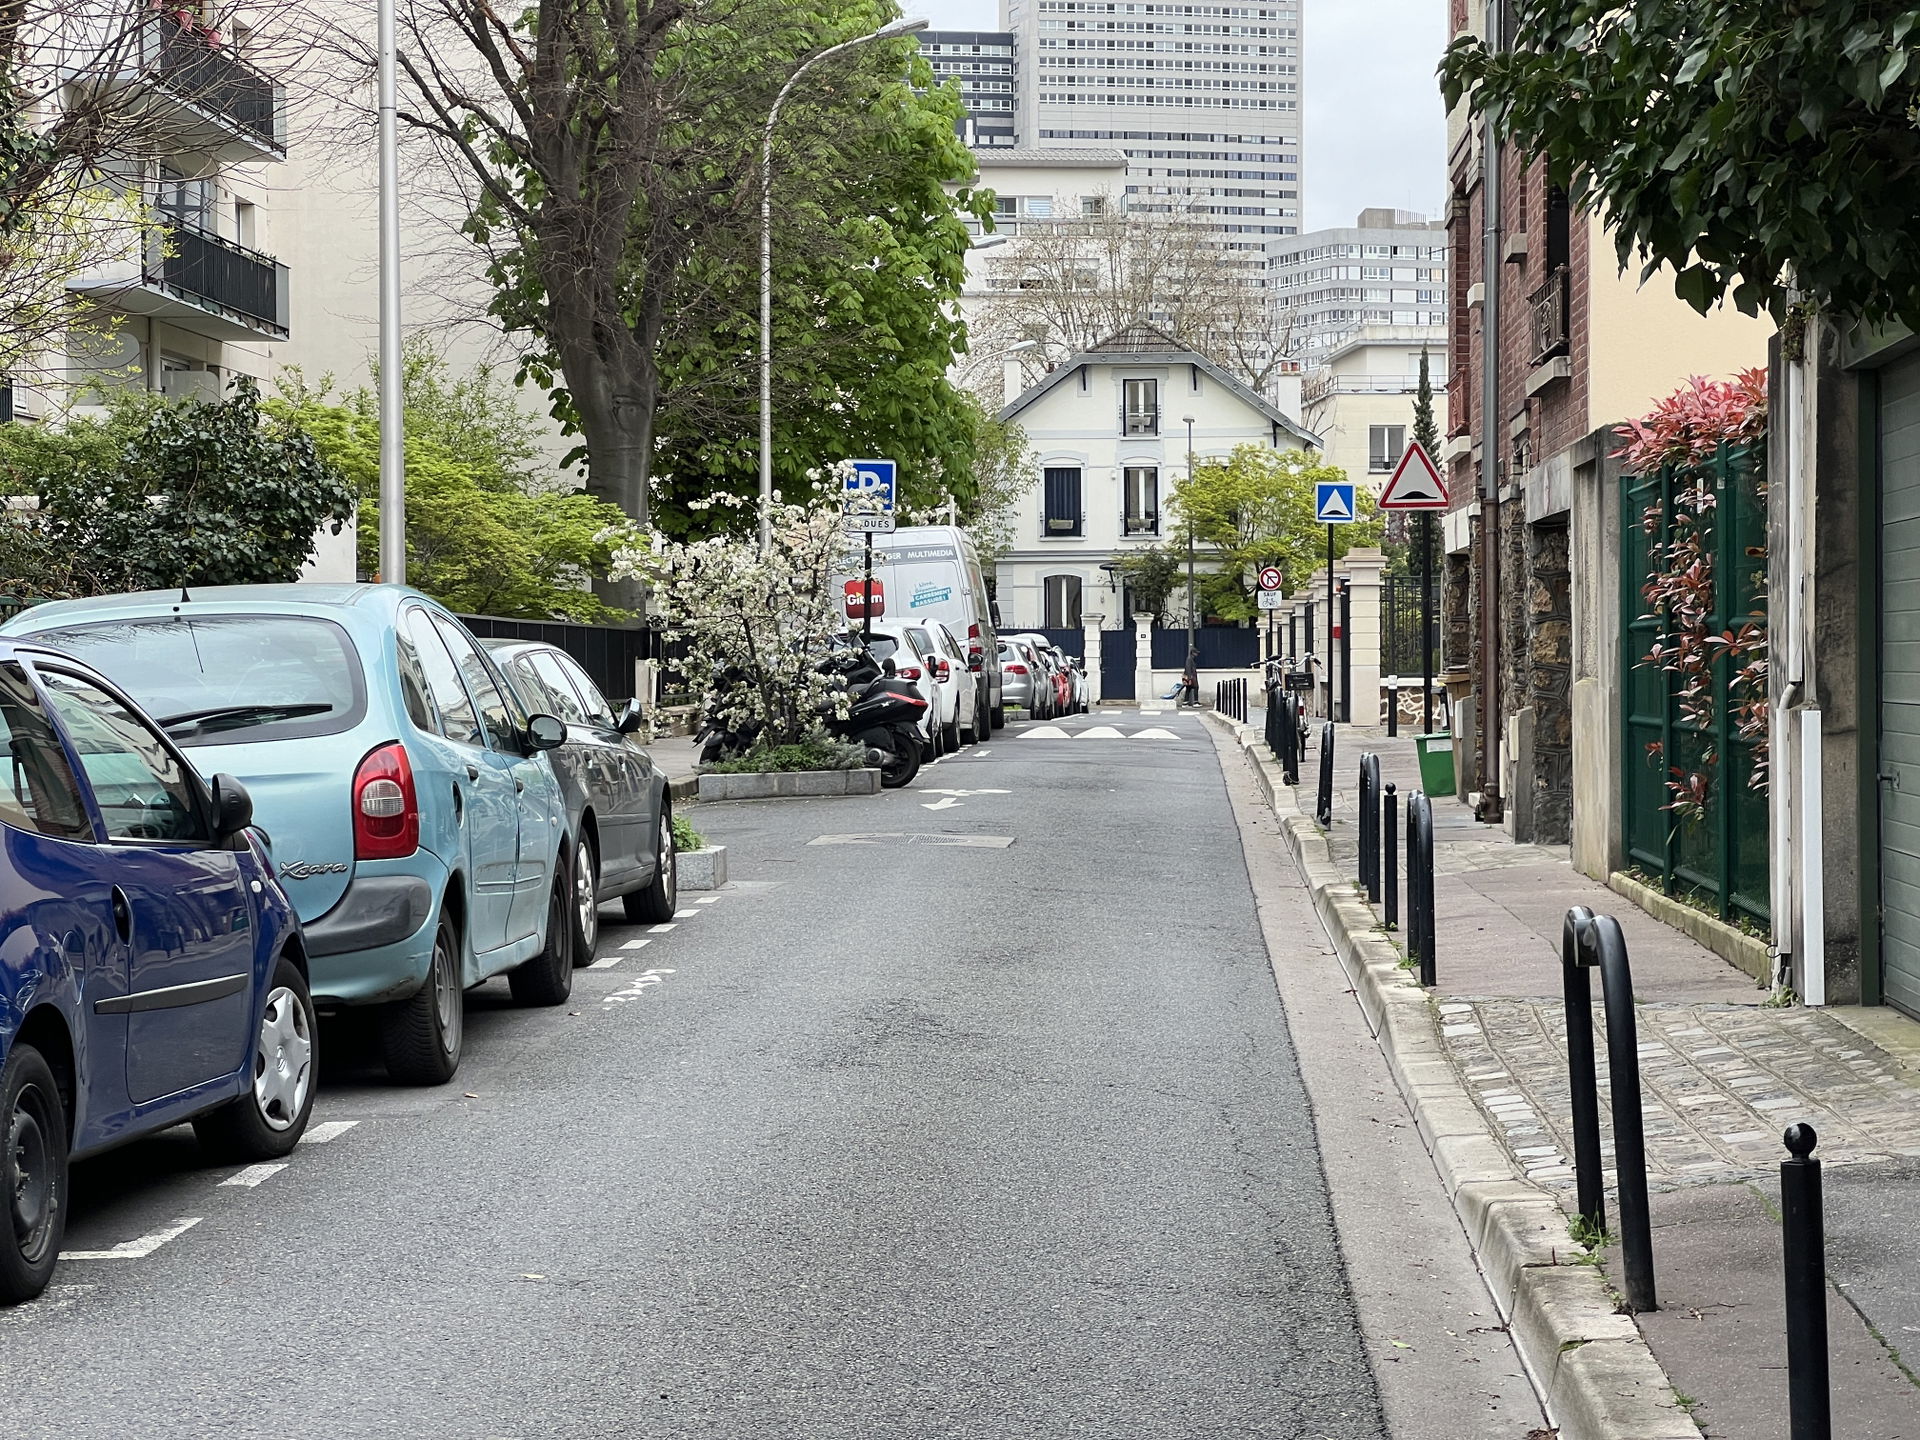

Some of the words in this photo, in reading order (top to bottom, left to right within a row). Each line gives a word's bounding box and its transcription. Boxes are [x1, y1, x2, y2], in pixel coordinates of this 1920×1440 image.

[858, 470, 881, 497] P
[859, 520, 890, 529] OUES
[907, 548, 954, 560] MULTIMEDIA
[846, 593, 883, 606] Gitm
[279, 860, 349, 880] Xsara
